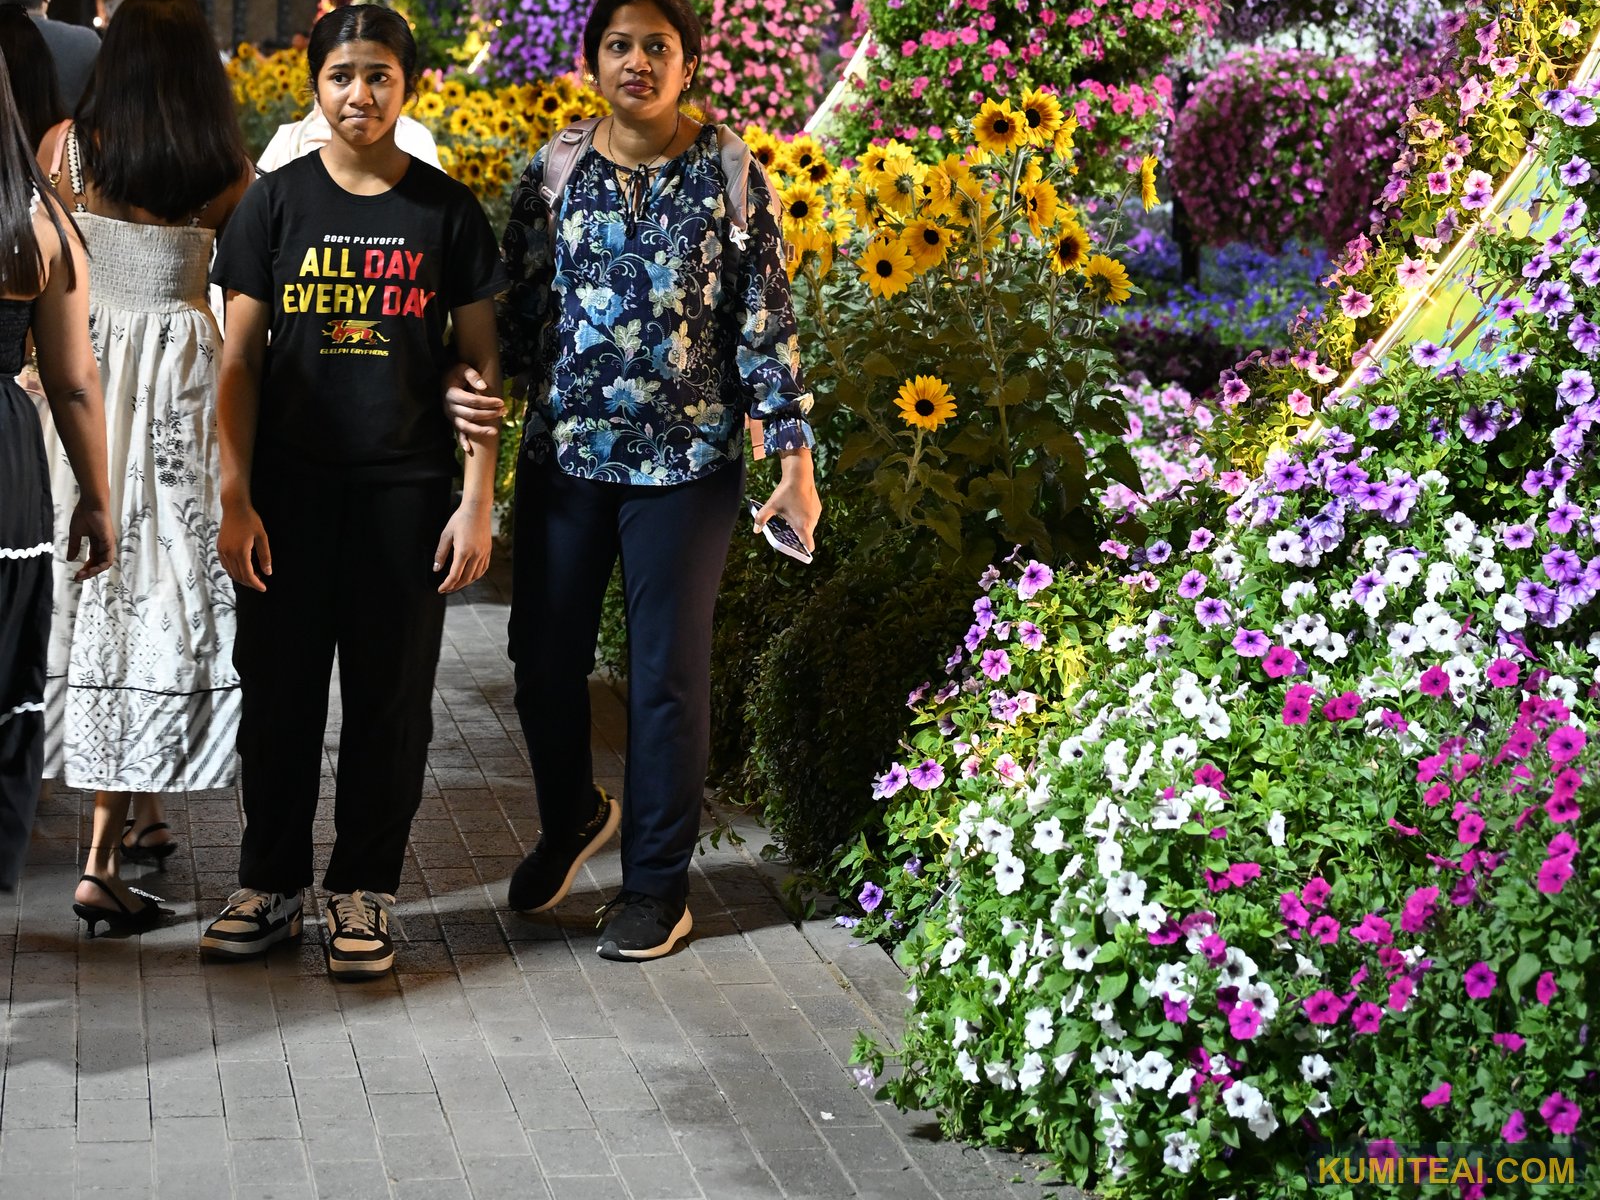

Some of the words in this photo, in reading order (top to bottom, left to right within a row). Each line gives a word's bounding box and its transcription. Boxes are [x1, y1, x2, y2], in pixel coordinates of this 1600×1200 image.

[323, 234, 350, 244] 2024
[353, 236, 405, 245] PLAYOFFS
[299, 247, 356, 278] ALL
[364, 249, 424, 280] DAY
[283, 284, 376, 315] EVERY
[381, 286, 436, 319] DAY
